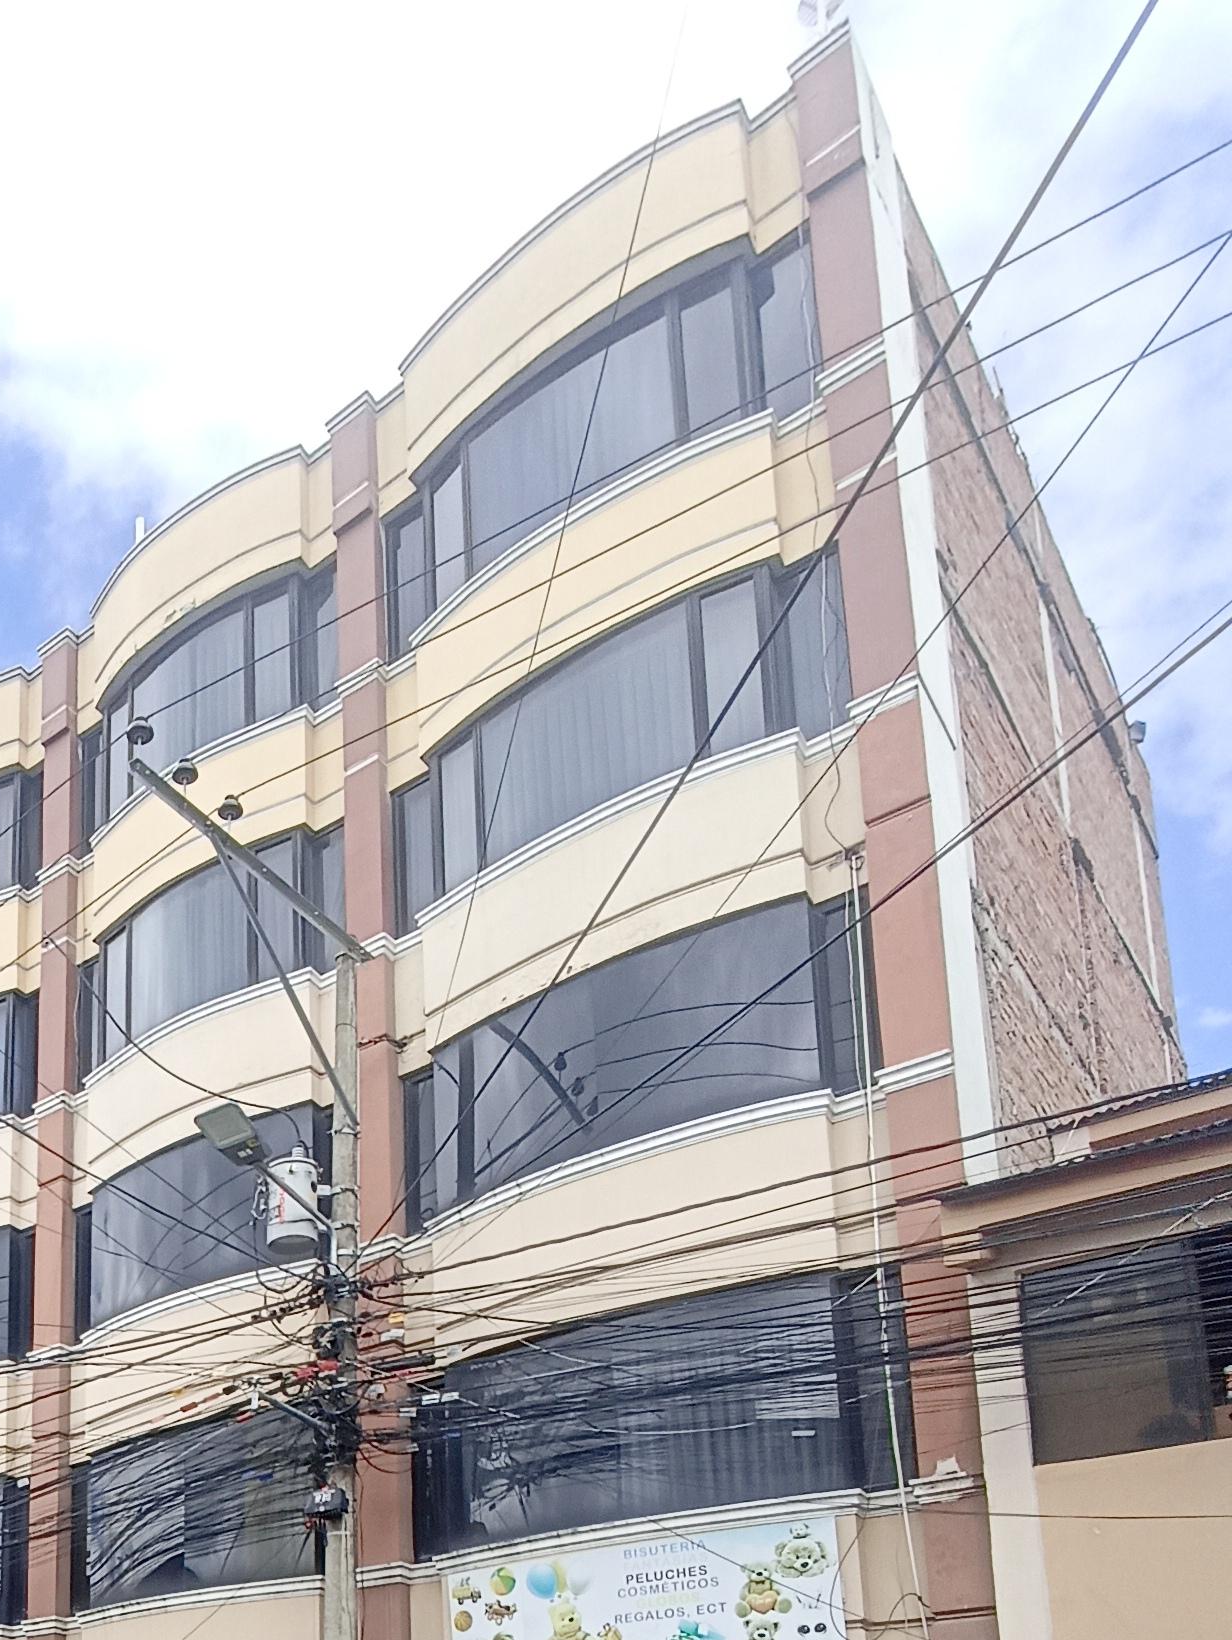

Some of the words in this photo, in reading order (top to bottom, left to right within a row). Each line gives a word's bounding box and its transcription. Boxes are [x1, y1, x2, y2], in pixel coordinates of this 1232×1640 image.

[625, 1565, 708, 1584] PELUCHES
[617, 1577, 720, 1598] COSMÉTICOS
[614, 1607, 690, 1625] REGALOS,
[696, 1602, 728, 1615] ECT
